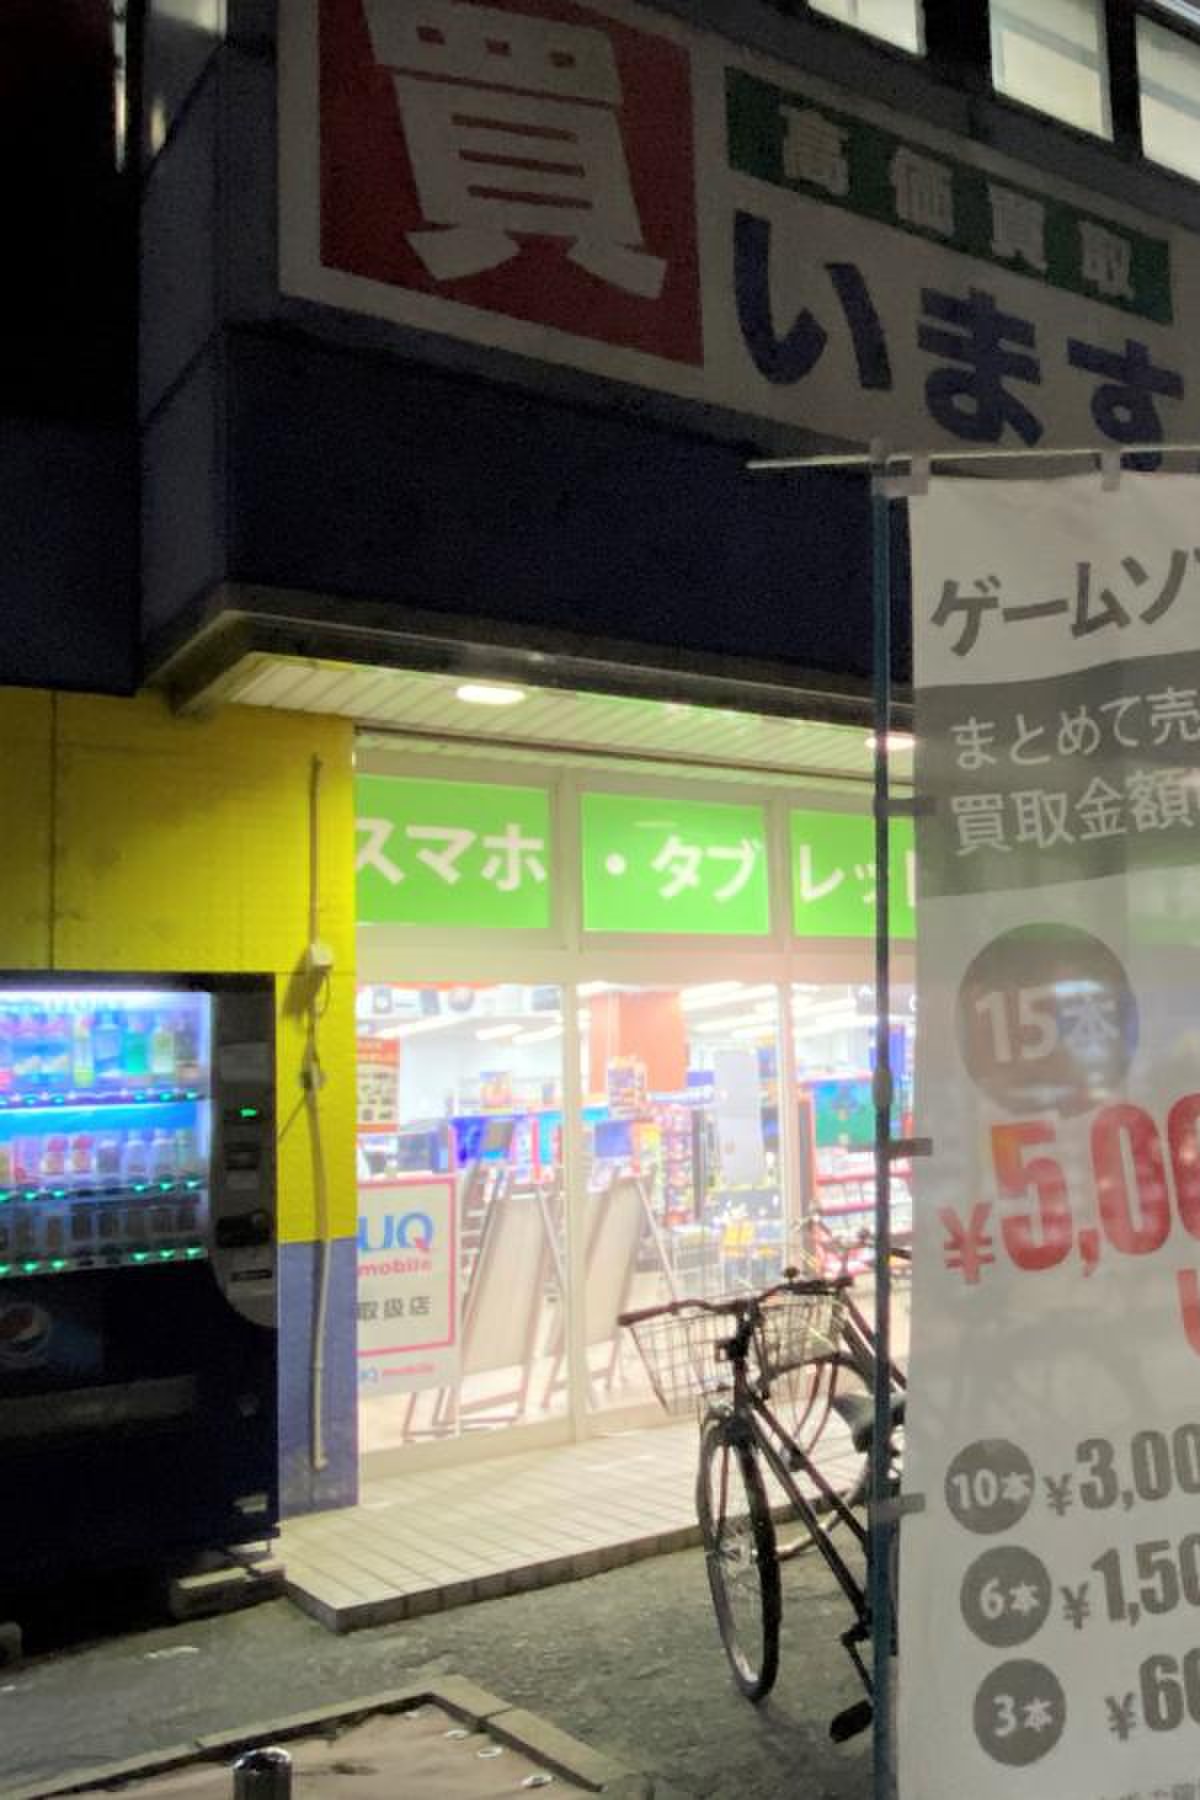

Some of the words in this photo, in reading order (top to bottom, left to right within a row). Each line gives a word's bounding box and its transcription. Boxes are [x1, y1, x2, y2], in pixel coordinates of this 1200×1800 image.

[361, 0, 667, 300] 買
[975, 988, 1122, 1065] 15本
[357, 1212, 434, 1253] UQ
